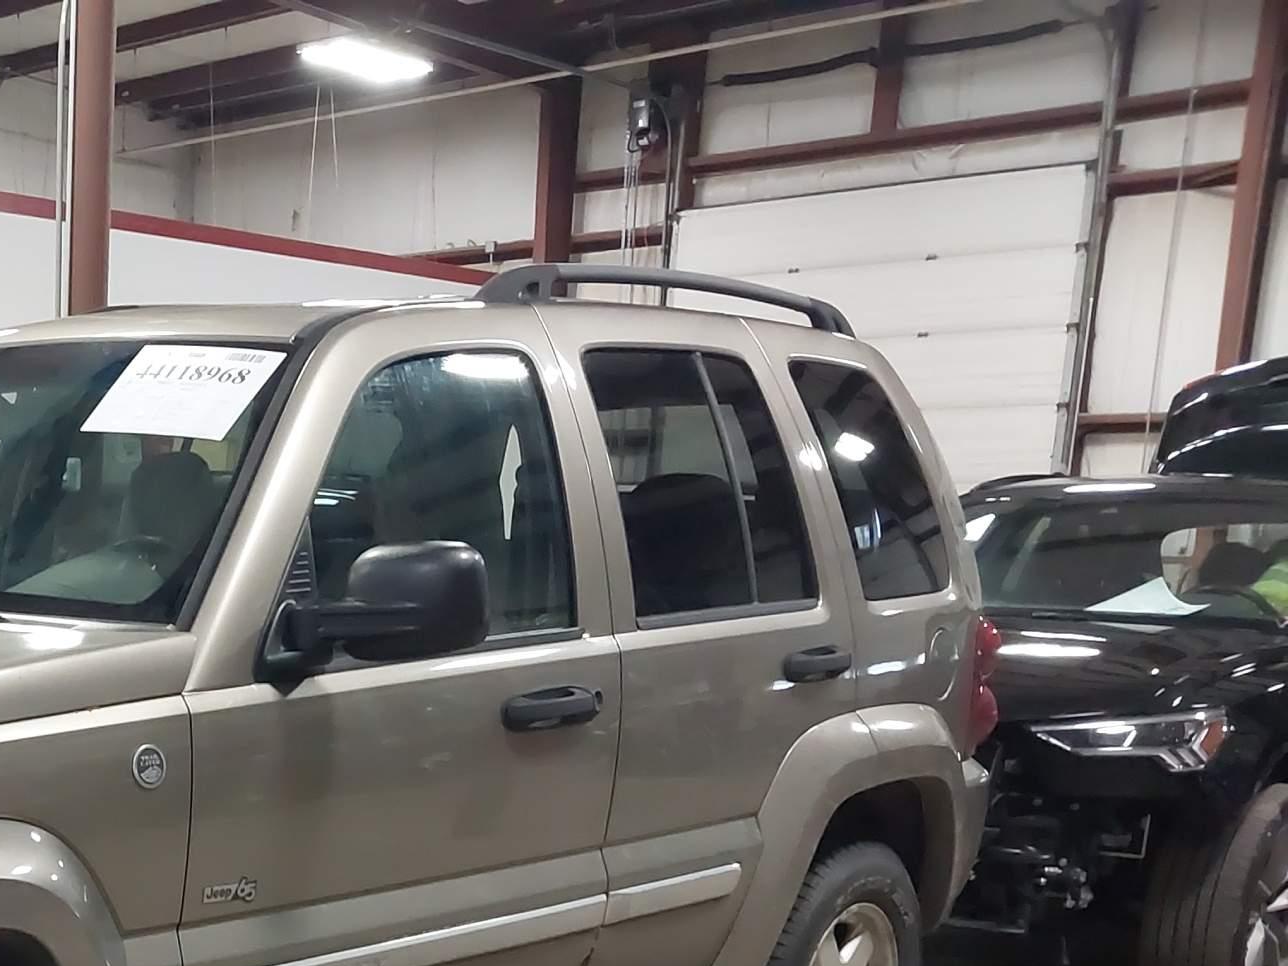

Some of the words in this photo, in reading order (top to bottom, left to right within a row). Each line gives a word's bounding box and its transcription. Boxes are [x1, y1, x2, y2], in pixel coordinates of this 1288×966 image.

[136, 363, 252, 385] 44118968
[206, 886, 232, 900] Jeep
[237, 878, 257, 901] 65
